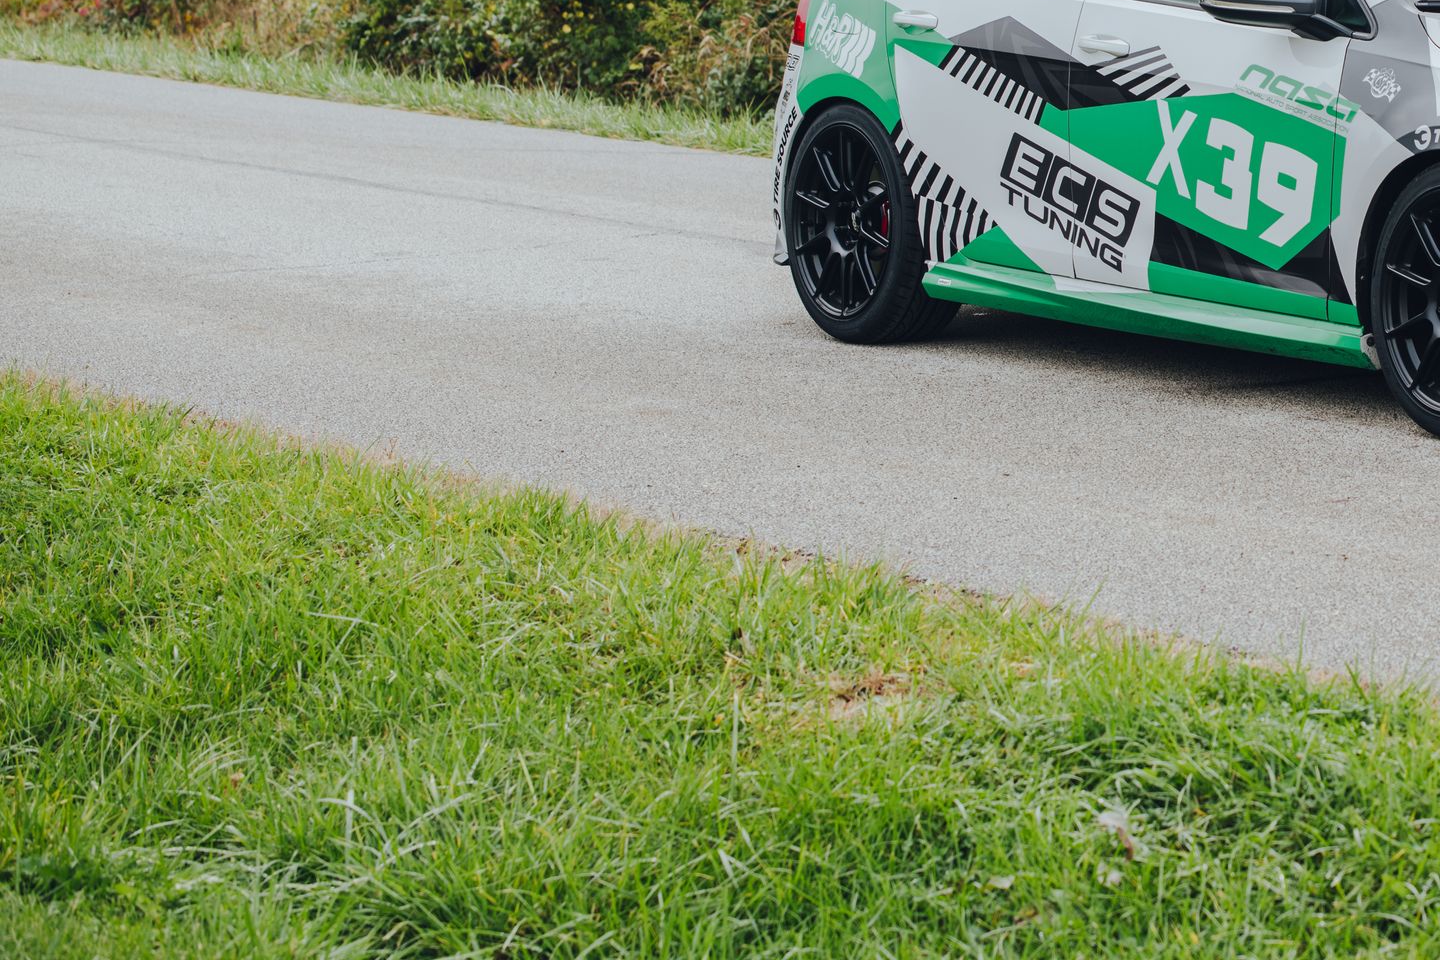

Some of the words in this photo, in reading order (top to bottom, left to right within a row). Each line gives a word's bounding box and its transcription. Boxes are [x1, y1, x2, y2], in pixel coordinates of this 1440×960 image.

[777, 106, 797, 167] SOURCE
[1146, 99, 1318, 247] X39
[1000, 181, 1123, 273] TUNING
[1003, 135, 1137, 244] ECS
